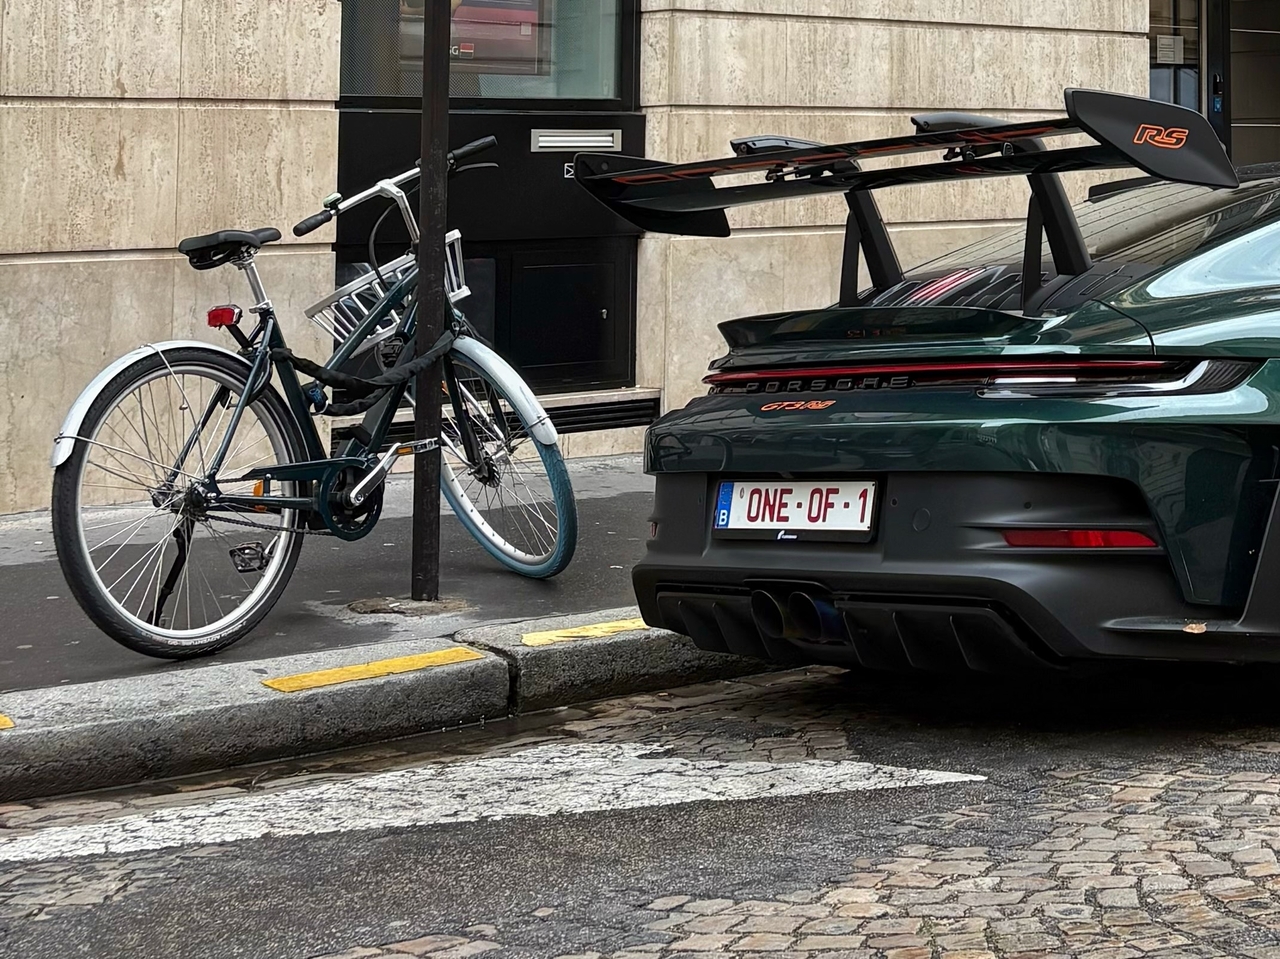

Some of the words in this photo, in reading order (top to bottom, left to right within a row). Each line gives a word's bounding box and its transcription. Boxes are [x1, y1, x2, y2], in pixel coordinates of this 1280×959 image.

[1134, 124, 1189, 149] RS
[745, 376, 910, 393] PORSCHE
[718, 509, 729, 525] B
